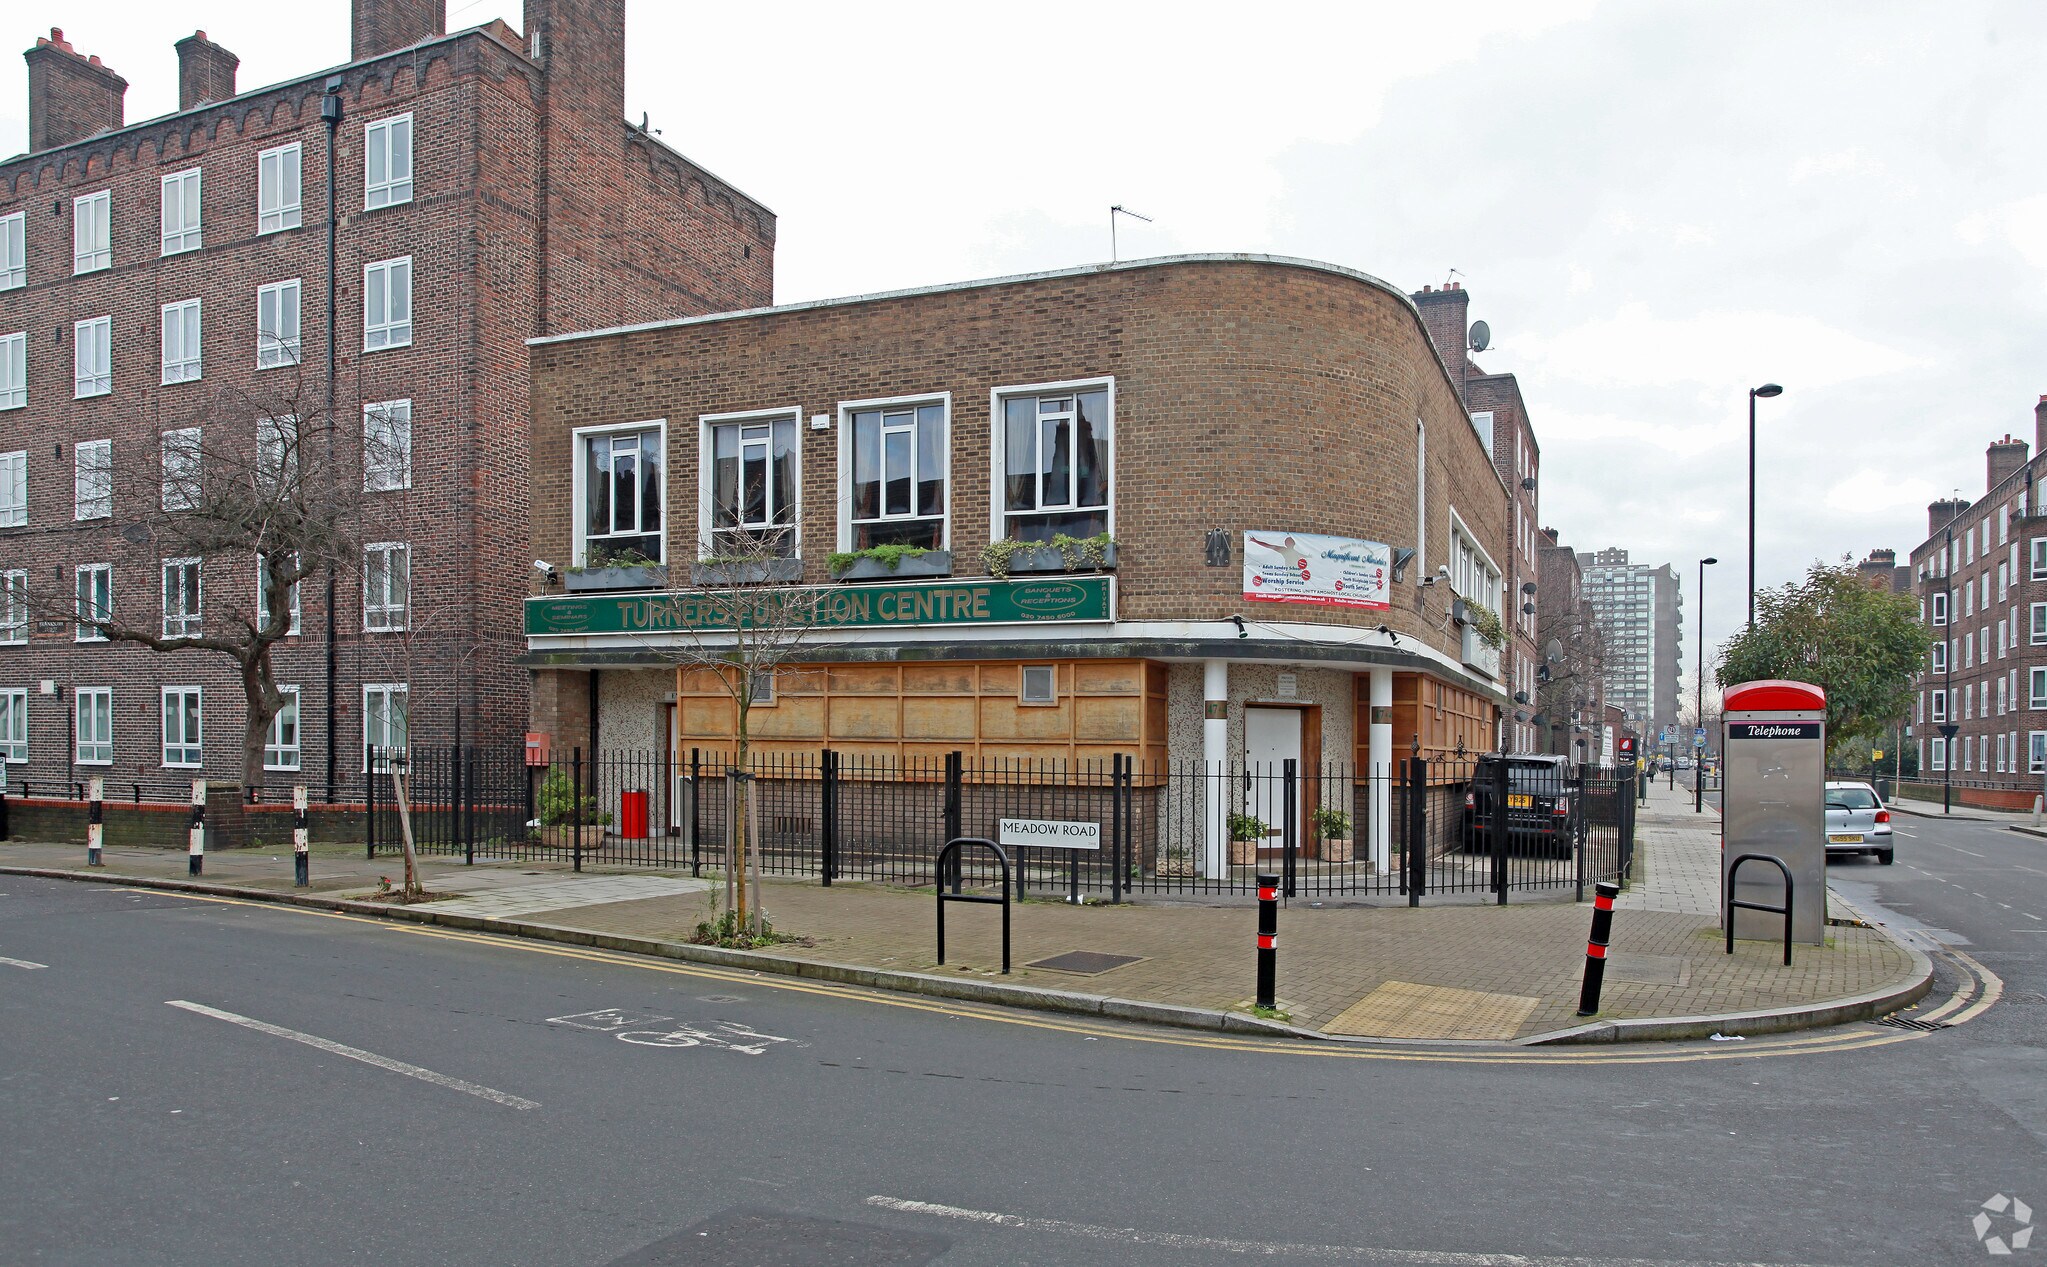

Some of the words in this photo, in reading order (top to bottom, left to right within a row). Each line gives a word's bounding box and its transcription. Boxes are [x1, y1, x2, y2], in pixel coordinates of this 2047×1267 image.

[1262, 578, 1285, 586] Worship
[1020, 597, 1077, 605] RECEPTIONS
[616, 597, 730, 630] TURNERS
[877, 588, 991, 622] CENTRE
[1747, 725, 1802, 738] Telephone
[1003, 822, 1059, 835] MEADOW
[1063, 825, 1096, 837] ROAD
